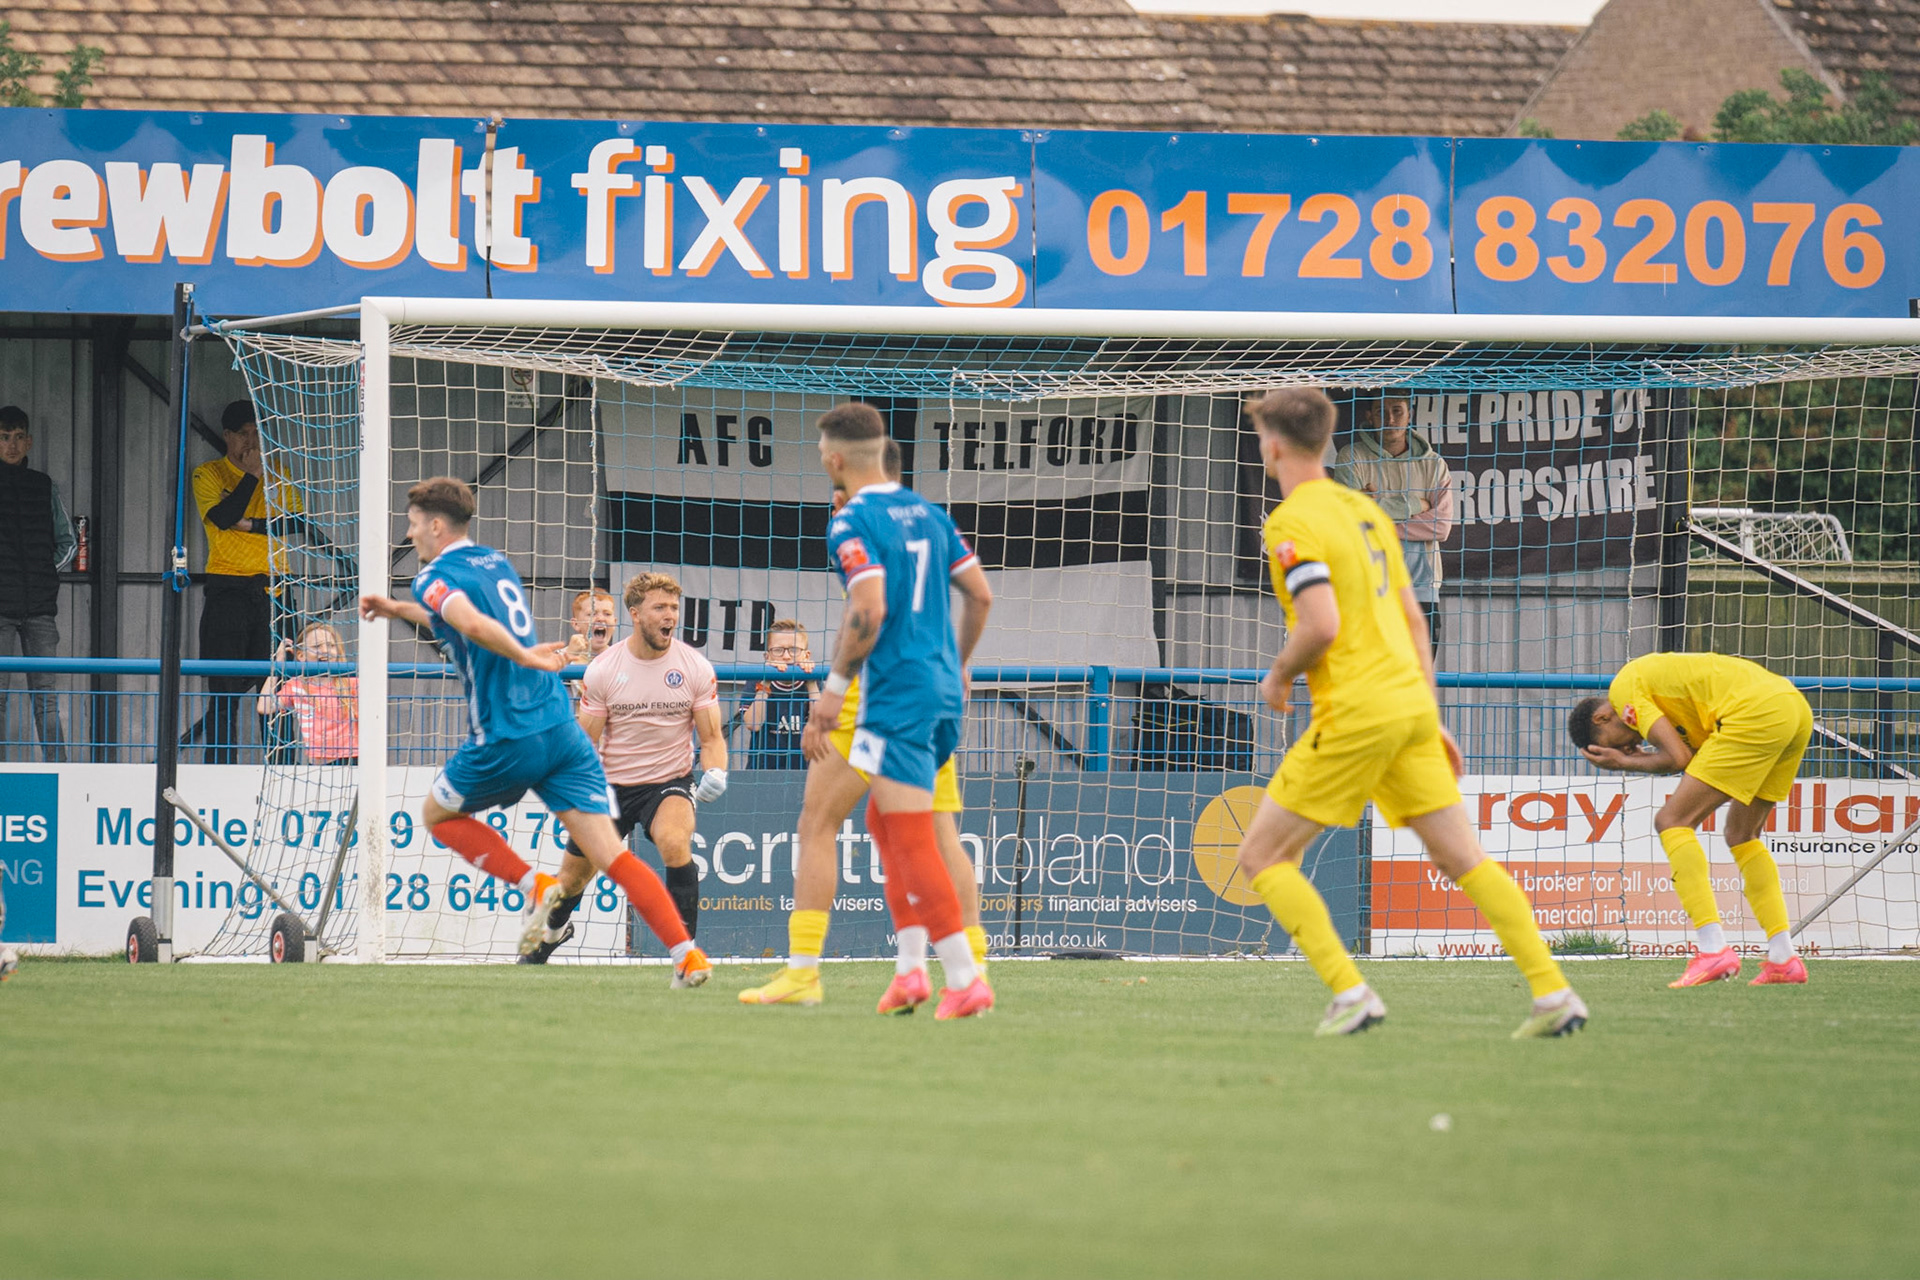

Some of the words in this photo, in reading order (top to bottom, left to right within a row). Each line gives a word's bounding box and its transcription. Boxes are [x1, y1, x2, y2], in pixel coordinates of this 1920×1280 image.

[571, 138, 1025, 307] fixing
[1087, 189, 1433, 281] 01728
[1474, 196, 1886, 290] 832076
[677, 412, 773, 468] AFC
[933, 412, 1138, 471] TELFORD
[1412, 394, 1468, 444] HE
[1478, 389, 1604, 443] PRIDE
[1450, 454, 1657, 526] ROPSHIRE
[905, 537, 932, 613] 7
[1359, 521, 1389, 597] 5
[496, 578, 532, 638] 8
[682, 597, 776, 651] UTD
[0, 814, 48, 843] ES
[282, 810, 413, 849] 0789
[1478, 792, 1630, 843] ray
[1771, 839, 1876, 854] insurance
[299, 872, 430, 911] 0128
[1048, 895, 1119, 912] financial
[1125, 896, 1198, 912] advisers
[1427, 869, 1463, 892] You
[1524, 870, 1582, 892] broker
[1590, 870, 1615, 892] for
[1619, 871, 1642, 892] all
[1604, 904, 1688, 925] insurance
